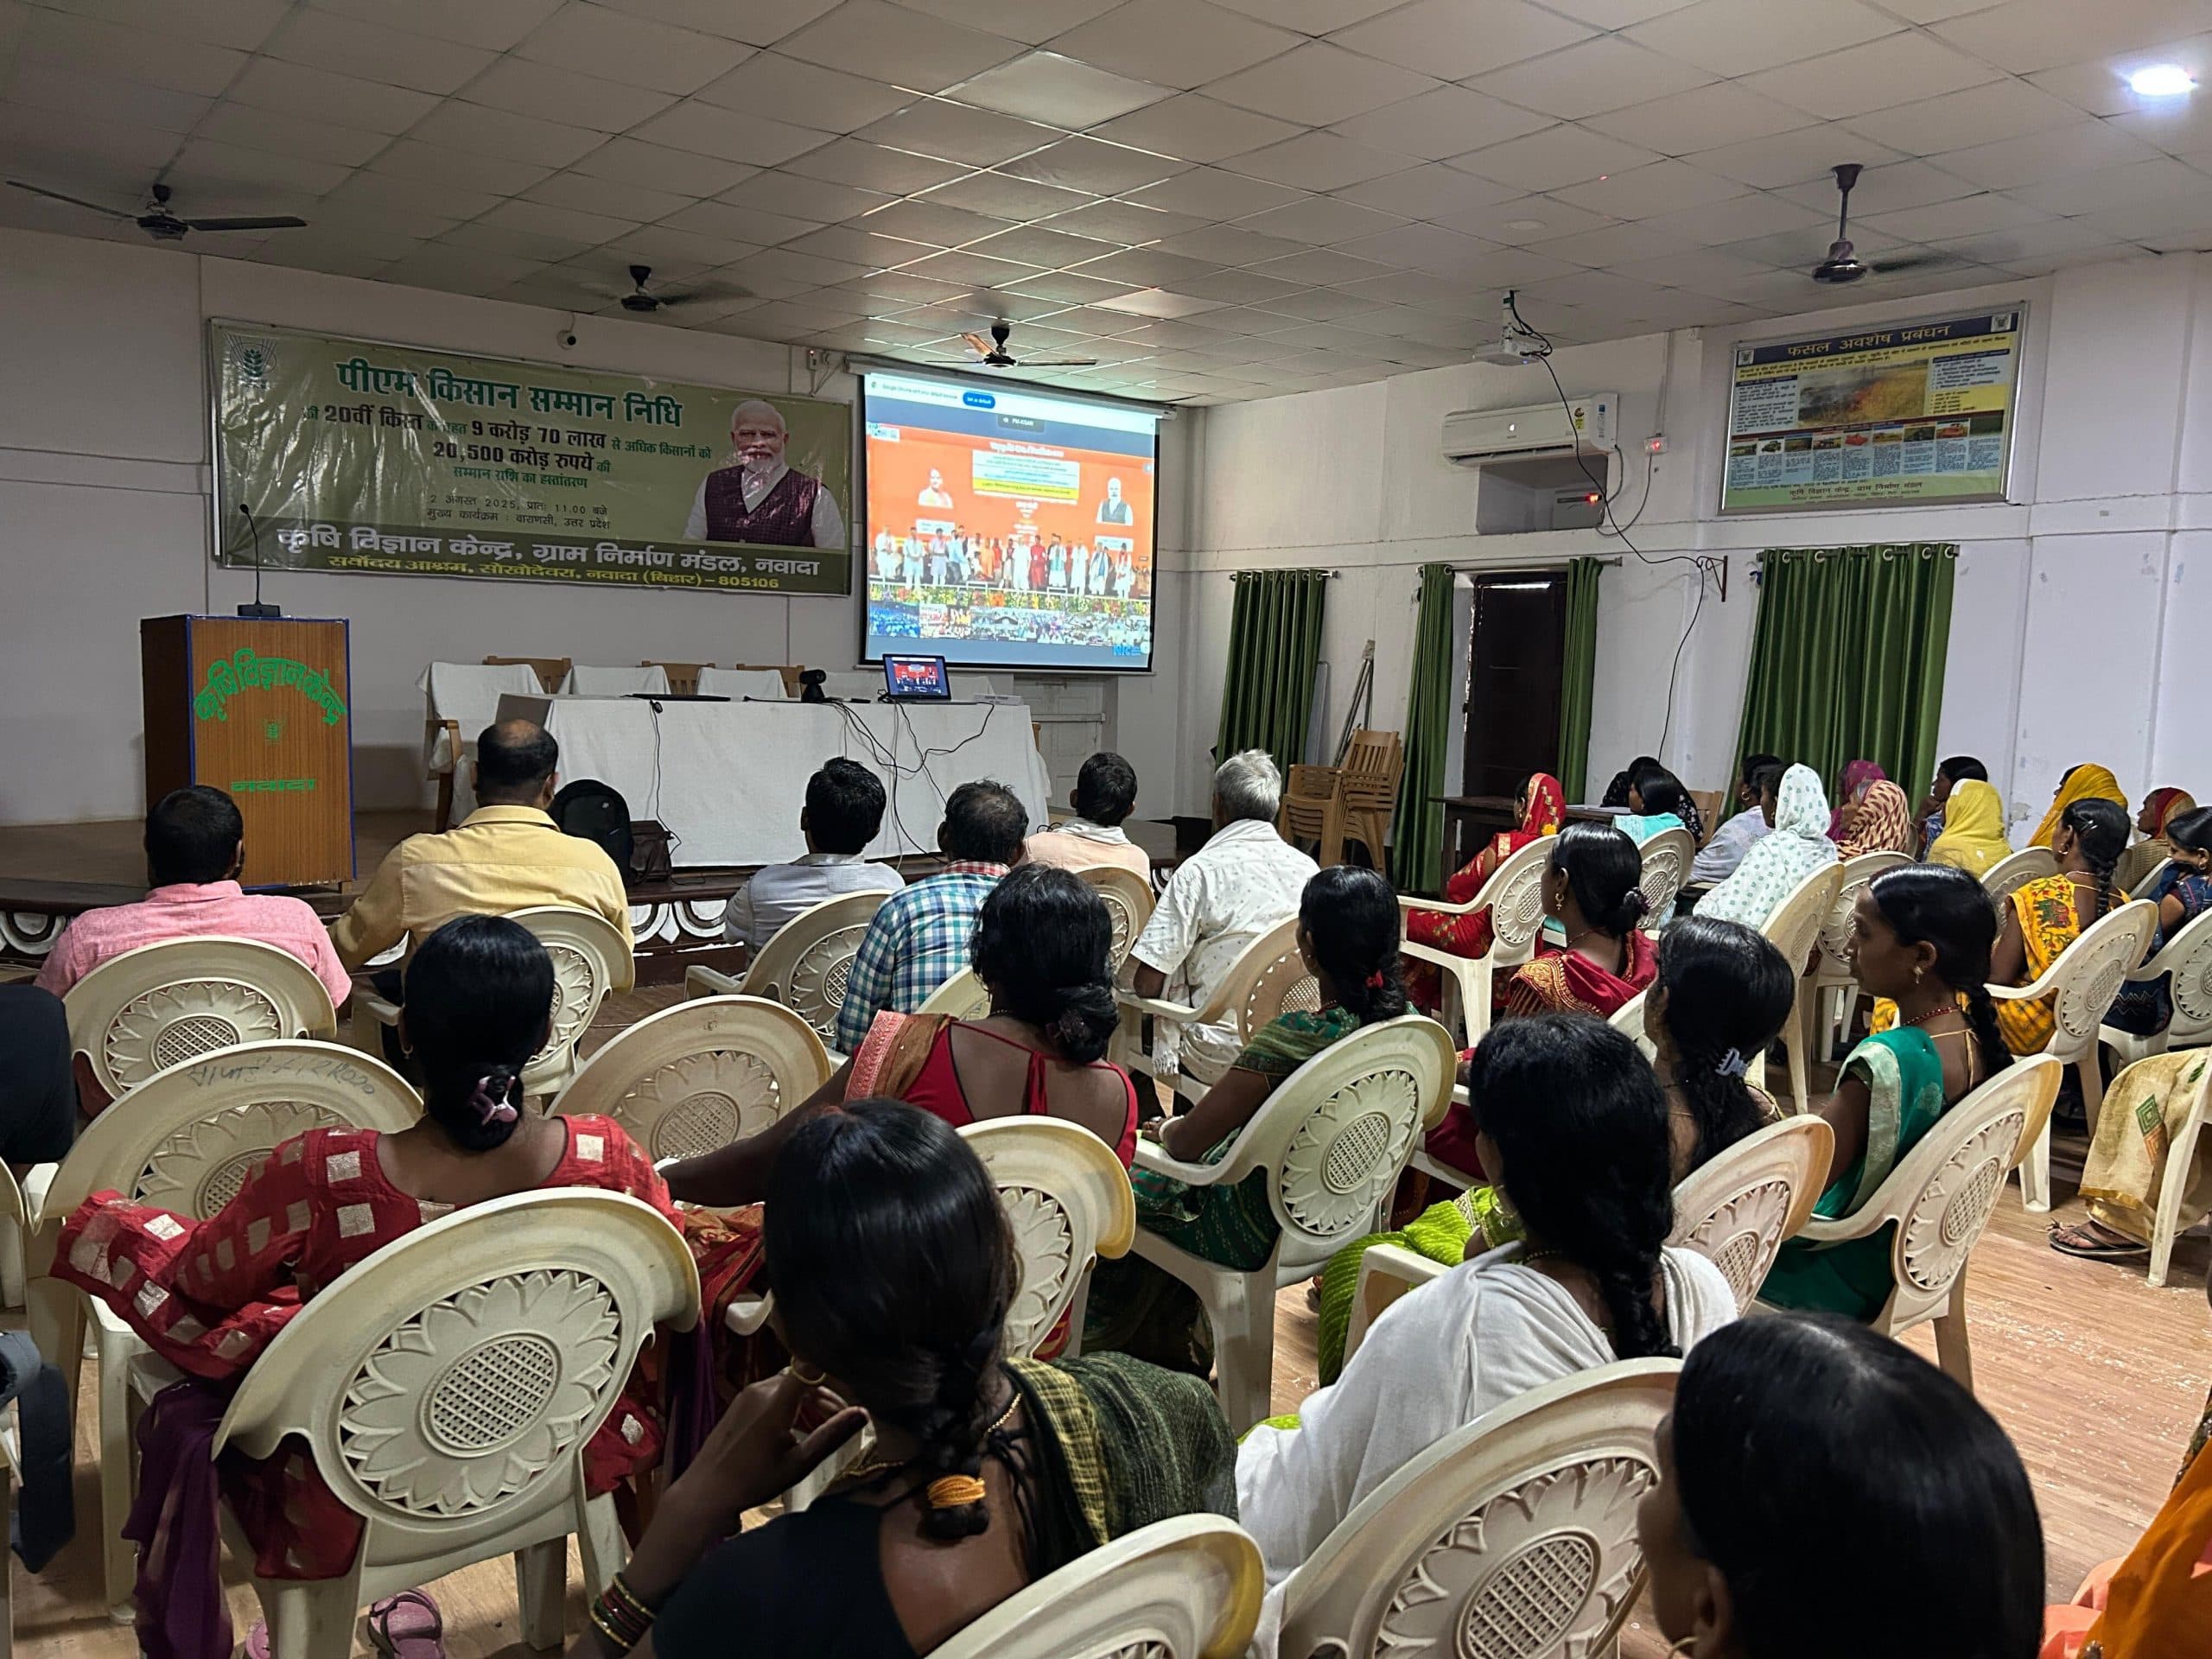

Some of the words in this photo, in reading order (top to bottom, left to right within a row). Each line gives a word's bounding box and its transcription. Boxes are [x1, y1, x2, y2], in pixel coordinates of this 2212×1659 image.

[1787, 340, 1832, 357] फसल
[1839, 333, 1894, 351] अवशेष
[1900, 325, 1951, 342] प्रबंधन
[335, 358, 418, 398] पीएम
[425, 367, 520, 410] किसान
[528, 386, 616, 421] सम्मान
[623, 391, 683, 428] निधि
[325, 404, 374, 425] 20वीं
[378, 406, 423, 430] किस्त
[472, 421, 483, 435] 9
[487, 419, 531, 445] करोड़
[537, 427, 560, 443] 70
[567, 430, 607, 448] लाख
[611, 436, 620, 451] से
[625, 439, 657, 454] अधिक
[659, 442, 696, 459] किसानों
[698, 446, 712, 460] को
[434, 442, 504, 463] 20,500
[508, 447, 550, 470] करोड़
[554, 451, 594, 472] रुपये
[596, 460, 611, 474] की
[454, 466, 491, 480] सम्मान
[494, 467, 518, 483] राशि
[522, 472, 536, 484] का
[539, 473, 588, 489] हस्तांतरण
[427, 508, 452, 521] मुख्य
[459, 508, 499, 521] कार्यक्रम
[563, 517, 583, 527] उत्तर
[589, 518, 610, 530] प्रदेश
[430, 495, 436, 504] 2
[445, 495, 477, 506] अगस्त
[593, 505, 608, 517] बजे
[276, 524, 342, 554] कृषि
[349, 526, 442, 554] विज्ञान
[448, 534, 523, 561] केन्द्र,
[532, 543, 588, 563] ग्राम
[594, 542, 675, 568] निर्माण
[680, 550, 747, 574] मंडल,
[754, 557, 820, 576] नवादा
[327, 555, 402, 569] सर्वोदय
[586, 569, 639, 582] नवादा
[718, 575, 779, 589] 805106
[193, 659, 238, 722] कृषि
[234, 648, 305, 692] विज्ञान
[302, 668, 347, 727] केन्द्र
[231, 779, 316, 793] नवादा
